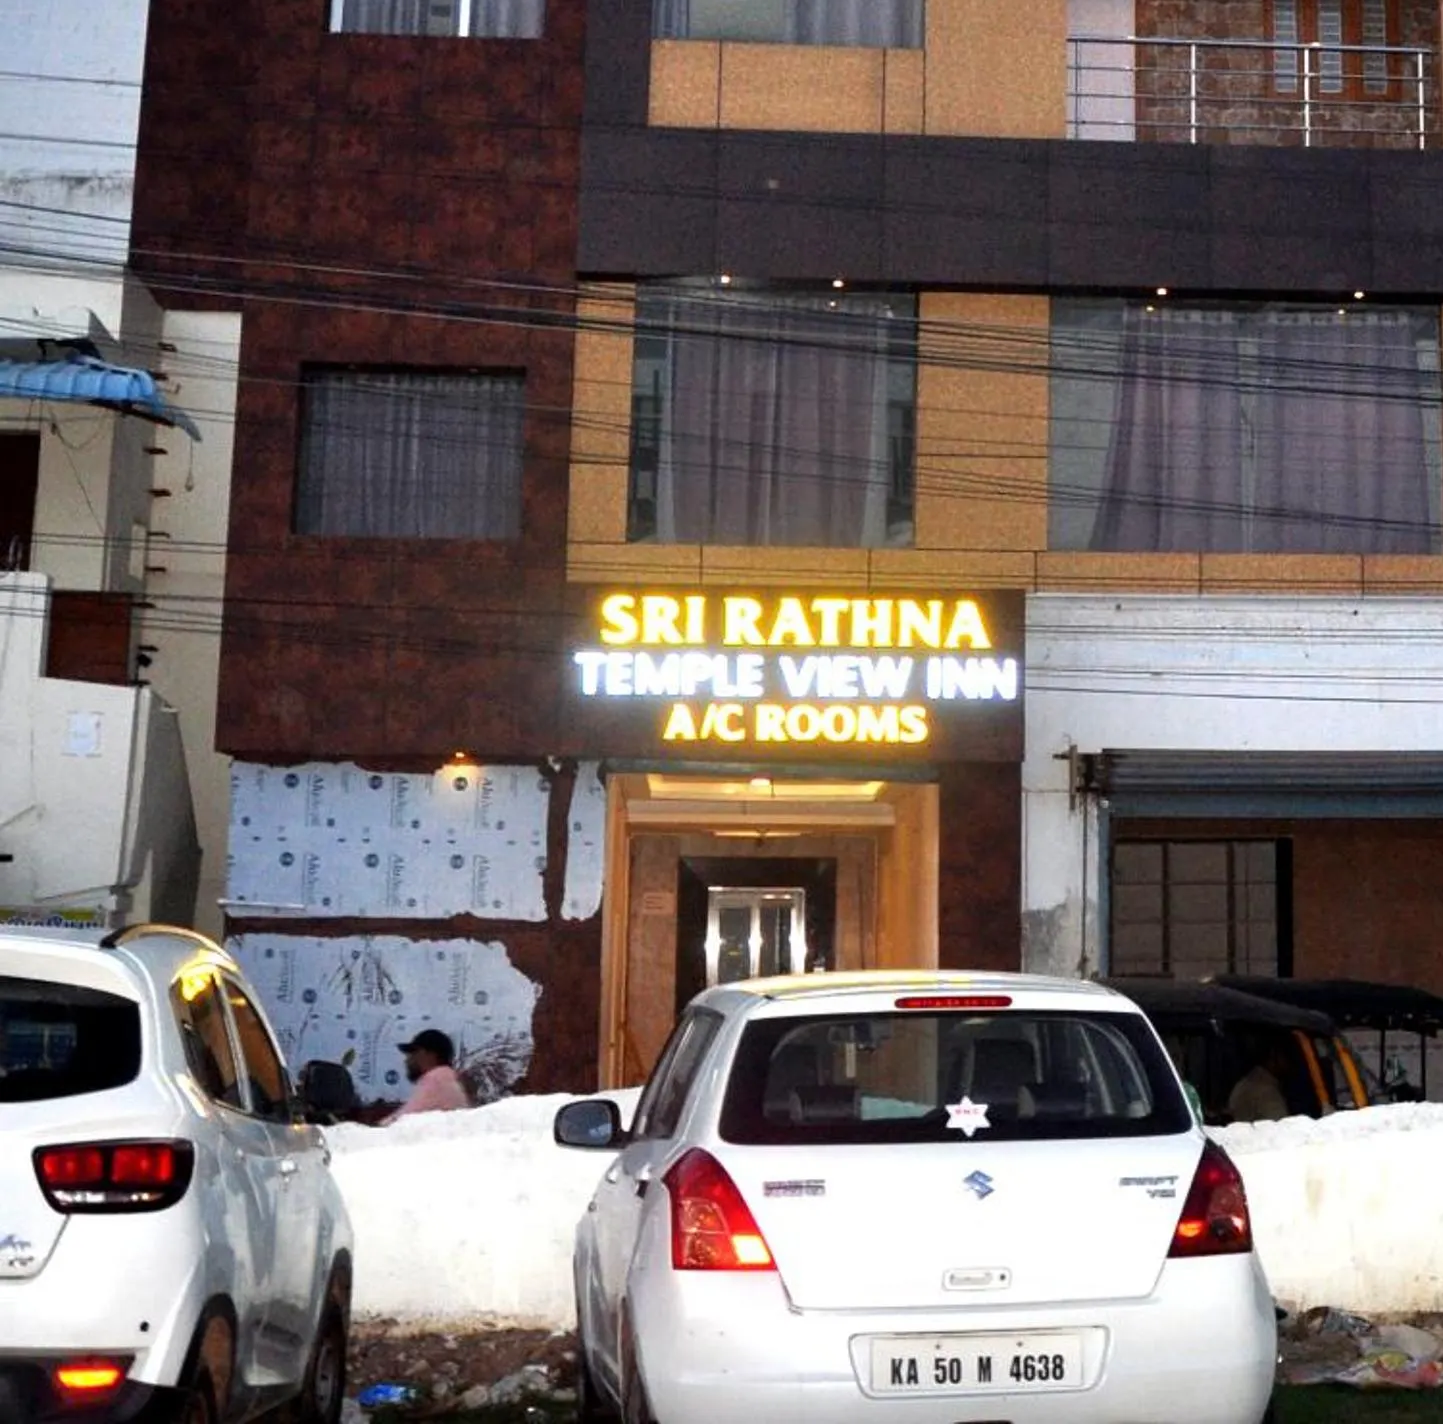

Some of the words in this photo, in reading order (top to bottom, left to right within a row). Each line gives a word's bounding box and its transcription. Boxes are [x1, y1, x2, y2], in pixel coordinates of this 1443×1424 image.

[600, 594, 706, 645] SRI
[723, 597, 992, 649] RATHNA
[575, 651, 764, 698] TEMPLE
[779, 655, 912, 699] VIEW
[926, 657, 1017, 700] INN
[663, 704, 745, 741] A/C
[755, 705, 928, 743] ROOMS
[890, 1357, 919, 1385] KA
[934, 1357, 962, 1384] 50
[977, 1356, 992, 1383] M
[1009, 1354, 1065, 1383] 4638
